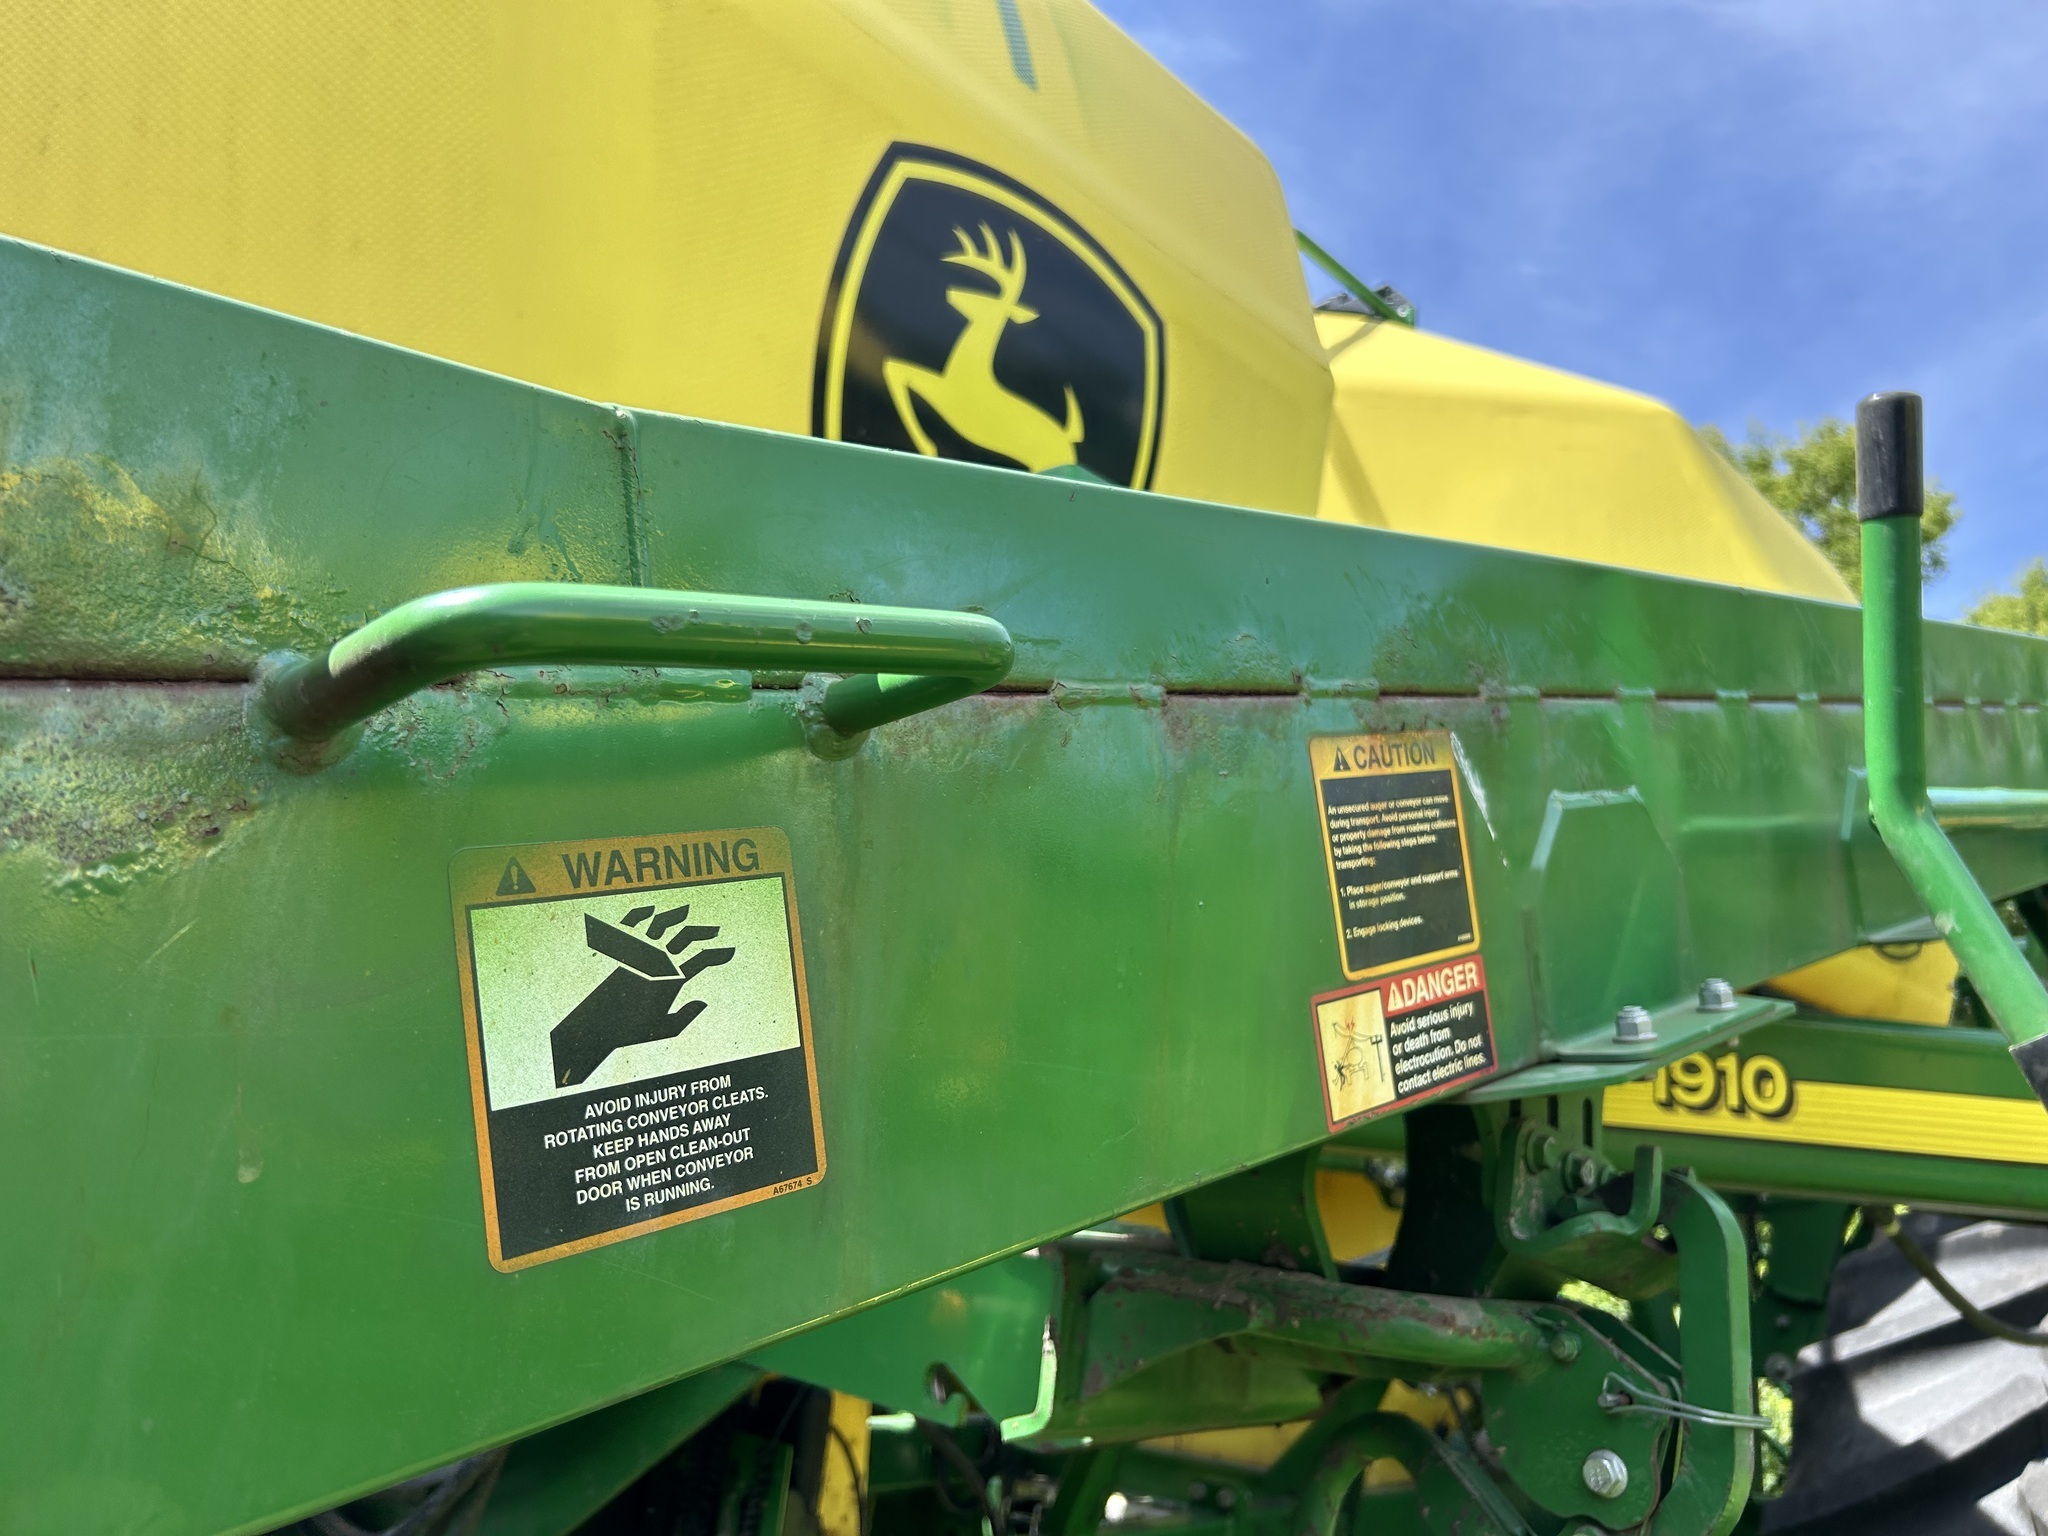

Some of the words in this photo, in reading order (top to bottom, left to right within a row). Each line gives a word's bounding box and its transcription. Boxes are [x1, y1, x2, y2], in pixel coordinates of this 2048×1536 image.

[1353, 741, 1436, 770] CAUTION
[1328, 805, 1337, 815] An
[1337, 801, 1370, 814] unsecured
[1370, 801, 1387, 813] auger
[1388, 801, 1395, 810] or
[1395, 797, 1422, 810] conveyor
[1422, 796, 1433, 805] can
[1433, 794, 1449, 804] move
[1330, 817, 1350, 829] during
[1382, 811, 1398, 823] Avoid
[1399, 809, 1423, 822] personal
[1424, 807, 1440, 819] injury
[1332, 834, 1339, 843] or
[1340, 829, 1366, 844] property
[1367, 826, 1391, 840] damage
[1391, 824, 1406, 835] from
[1406, 821, 1430, 834] roadway
[1334, 846, 1342, 858] by
[1342, 843, 1362, 856] taking
[1363, 841, 1373, 851] the
[1373, 838, 1400, 851] following
[1401, 836, 1417, 848] steps
[1418, 834, 1436, 845] before
[562, 838, 761, 889] WARNING
[1340, 888, 1346, 897] 1.
[1347, 885, 1364, 897] Place
[1364, 877, 1410, 894] auger/conveyor
[1411, 874, 1421, 886] and
[1422, 870, 1444, 885] support
[1349, 900, 1355, 910] in
[1356, 896, 1379, 910] storage
[1380, 892, 1406, 905] position.
[1346, 929, 1352, 939] 2.
[1353, 925, 1377, 938] Engage
[1377, 920, 1399, 933] locking
[1400, 915, 1424, 928] devices.
[1402, 961, 1480, 1007] DANGER
[1390, 1016, 1415, 1038] Avoid
[1416, 1007, 1449, 1030] serious
[1449, 1001, 1474, 1021] injury
[1392, 1043, 1402, 1056] or
[1404, 1032, 1430, 1052] death
[1430, 1026, 1451, 1043] from
[1394, 1046, 1454, 1076] electrocution.
[1454, 1038, 1467, 1054] Do
[1468, 1033, 1482, 1049] not
[1397, 1071, 1432, 1094] contact
[1432, 1059, 1463, 1081] electric
[1464, 1053, 1487, 1070] lines.
[1655, 1052, 1794, 1118] 1910
[584, 1096, 632, 1120] AVOID
[635, 1084, 688, 1110] INJURY
[691, 1074, 732, 1096] FROM
[544, 1120, 624, 1150] ROTATING
[626, 1101, 709, 1130] CONVEYOR
[712, 1086, 769, 1110] CLEATS.
[593, 1136, 634, 1159] KEEP
[638, 1122, 690, 1148] HANDS
[692, 1113, 733, 1136] AWAY
[575, 1160, 621, 1184] FROM
[624, 1150, 666, 1172] OPEN
[669, 1128, 751, 1160] CLEAN-OUT
[576, 1181, 623, 1205] DOOR
[626, 1167, 672, 1192] WHEN
[675, 1147, 754, 1179] CONVEYOR
[773, 1180, 802, 1195] A67674
[806, 1176, 812, 1186] S
[625, 1196, 641, 1212] IS
[644, 1178, 715, 1207] RUNNING.
